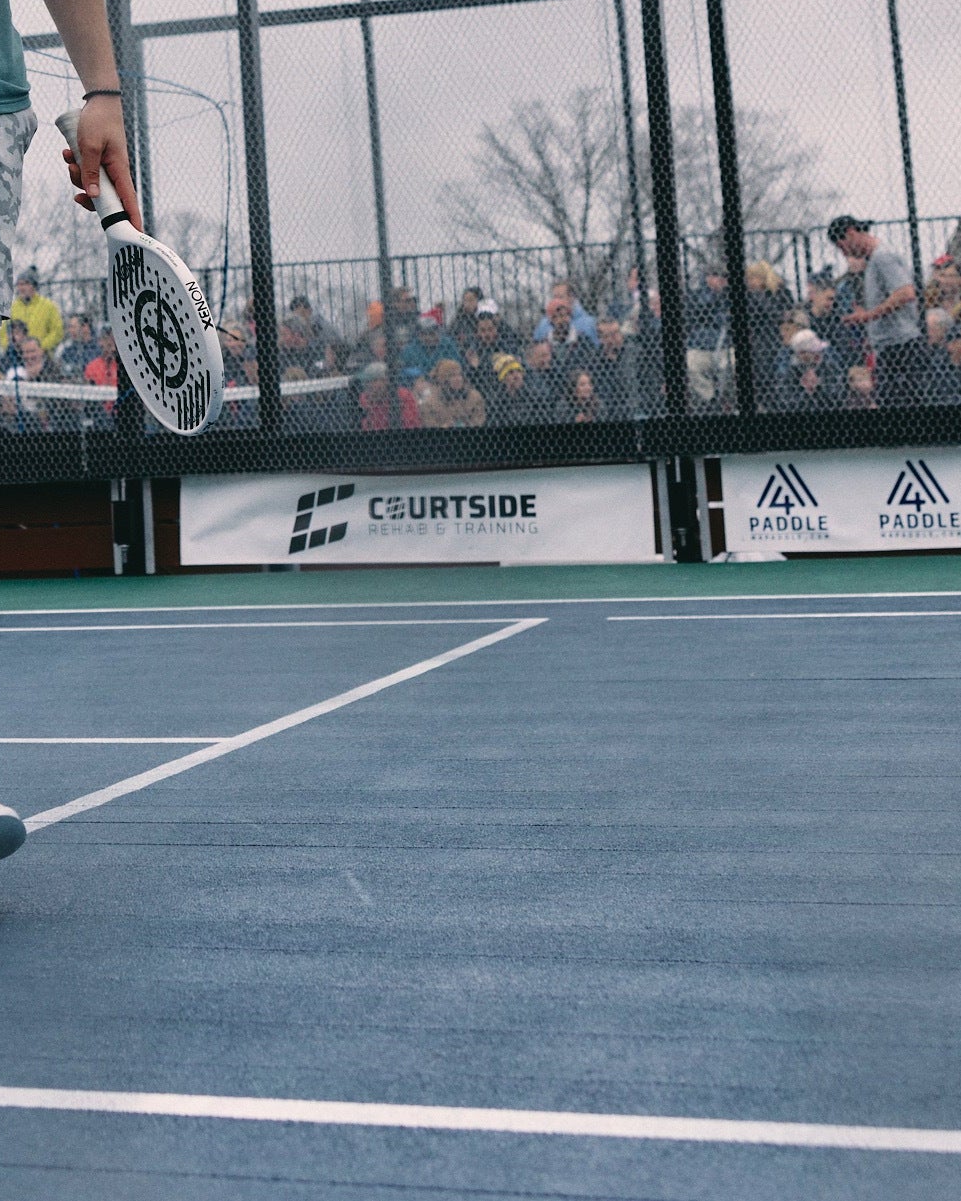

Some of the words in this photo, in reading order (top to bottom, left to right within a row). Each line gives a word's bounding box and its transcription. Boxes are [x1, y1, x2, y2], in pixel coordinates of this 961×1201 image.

[185, 281, 214, 331] XENON
[368, 494, 537, 520] COURTSIDE
[368, 523, 428, 536] REHAB
[454, 521, 539, 535] TRAINING
[749, 516, 828, 532] PADDLE
[879, 512, 960, 530] PADDLE
